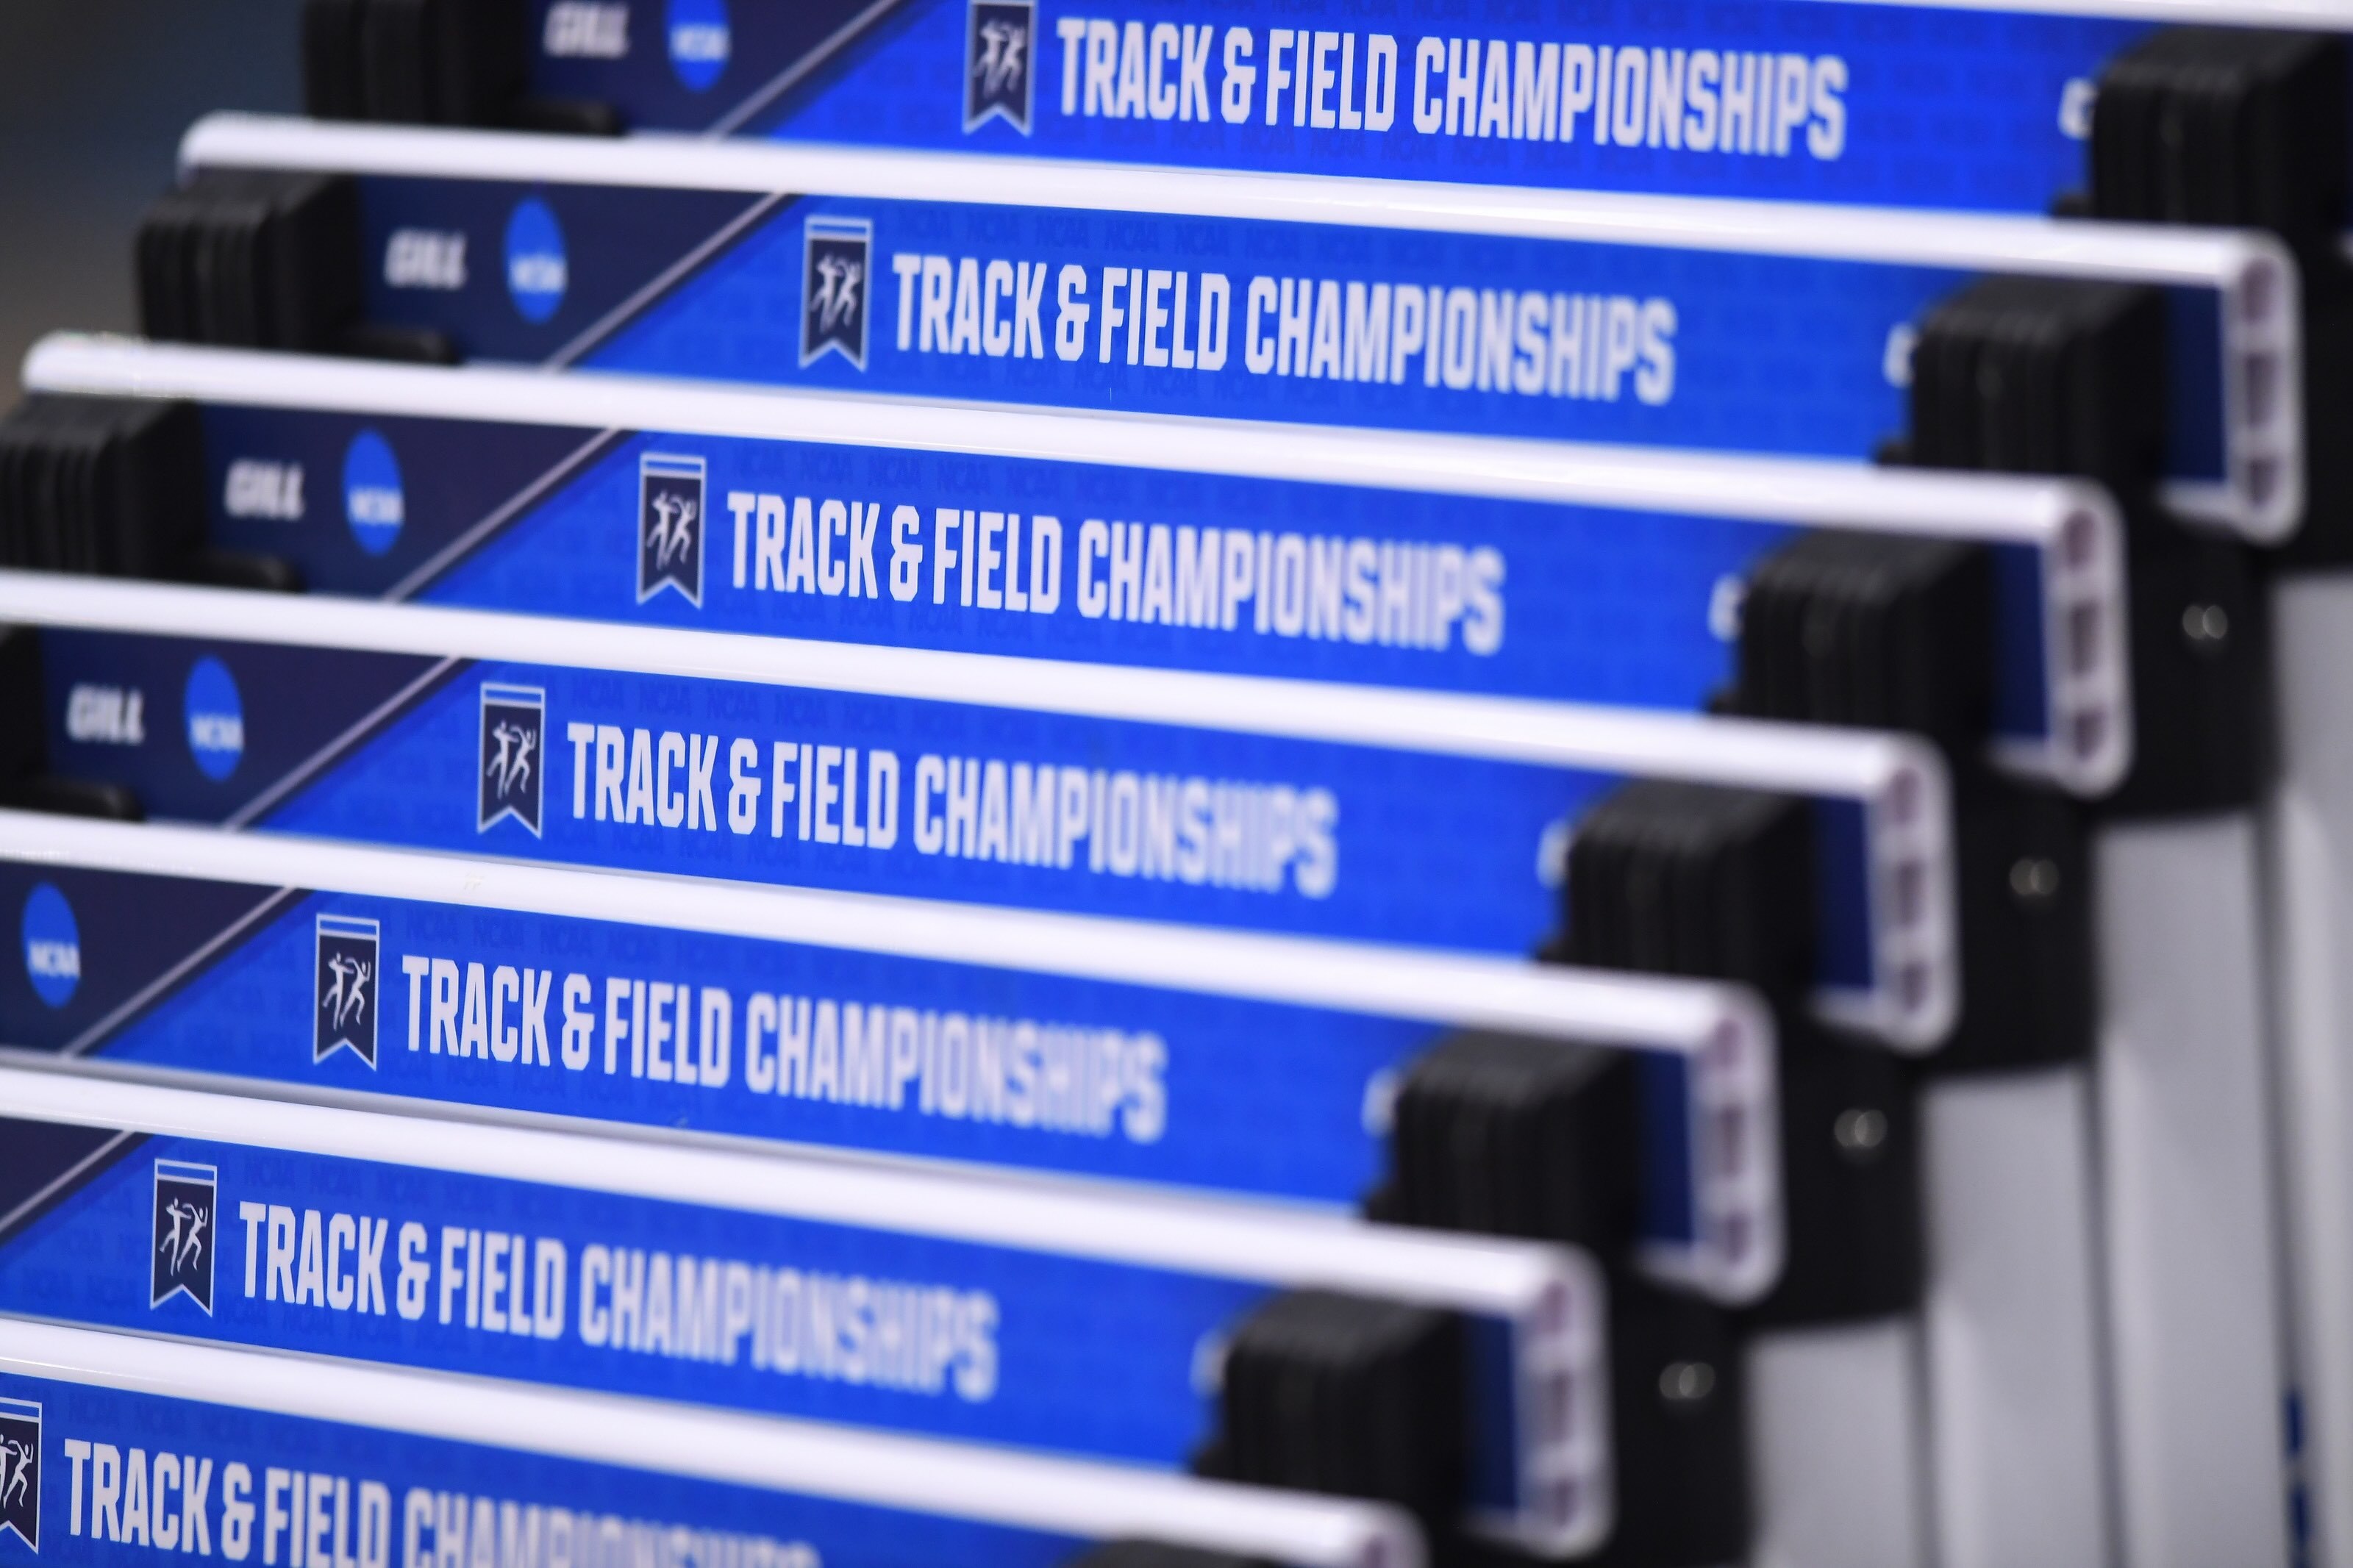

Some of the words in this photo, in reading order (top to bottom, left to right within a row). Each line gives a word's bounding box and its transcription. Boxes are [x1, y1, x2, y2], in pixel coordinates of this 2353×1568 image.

[1057, 18, 1214, 122] TRACK
[1221, 26, 1257, 123] &
[1265, 29, 1398, 132] FIELD
[1412, 37, 1847, 159] CHAMPIONSHIPS
[893, 254, 1048, 359] TRACK
[1054, 264, 1090, 362] &
[1099, 267, 1230, 371] FIELD
[1244, 276, 1677, 404] CHAMPIONSHIPS
[727, 491, 880, 599] TRACK
[889, 504, 924, 602] &
[933, 507, 1063, 614] FIELD
[1076, 518, 1506, 654] CHAMPIONSHIPS
[567, 723, 720, 831] TRACK
[728, 737, 762, 835] &
[771, 741, 899, 850] FIELD
[913, 754, 1340, 896] CHAMPIONSHIPS
[25, 938, 82, 978] NCAA
[402, 955, 552, 1067] TRACK
[561, 973, 595, 1071] &
[604, 977, 732, 1087] FIELD
[745, 992, 1167, 1142] CHAMPIONSHIPS
[239, 1201, 388, 1315] TRACK
[396, 1222, 430, 1320] &
[439, 1227, 567, 1339] FIELD
[579, 1245, 999, 1400] CHAMPIONSHIPS
[64, 1438, 213, 1556] TRACK
[221, 1462, 255, 1560] &
[264, 1468, 390, 1568] FIELD
